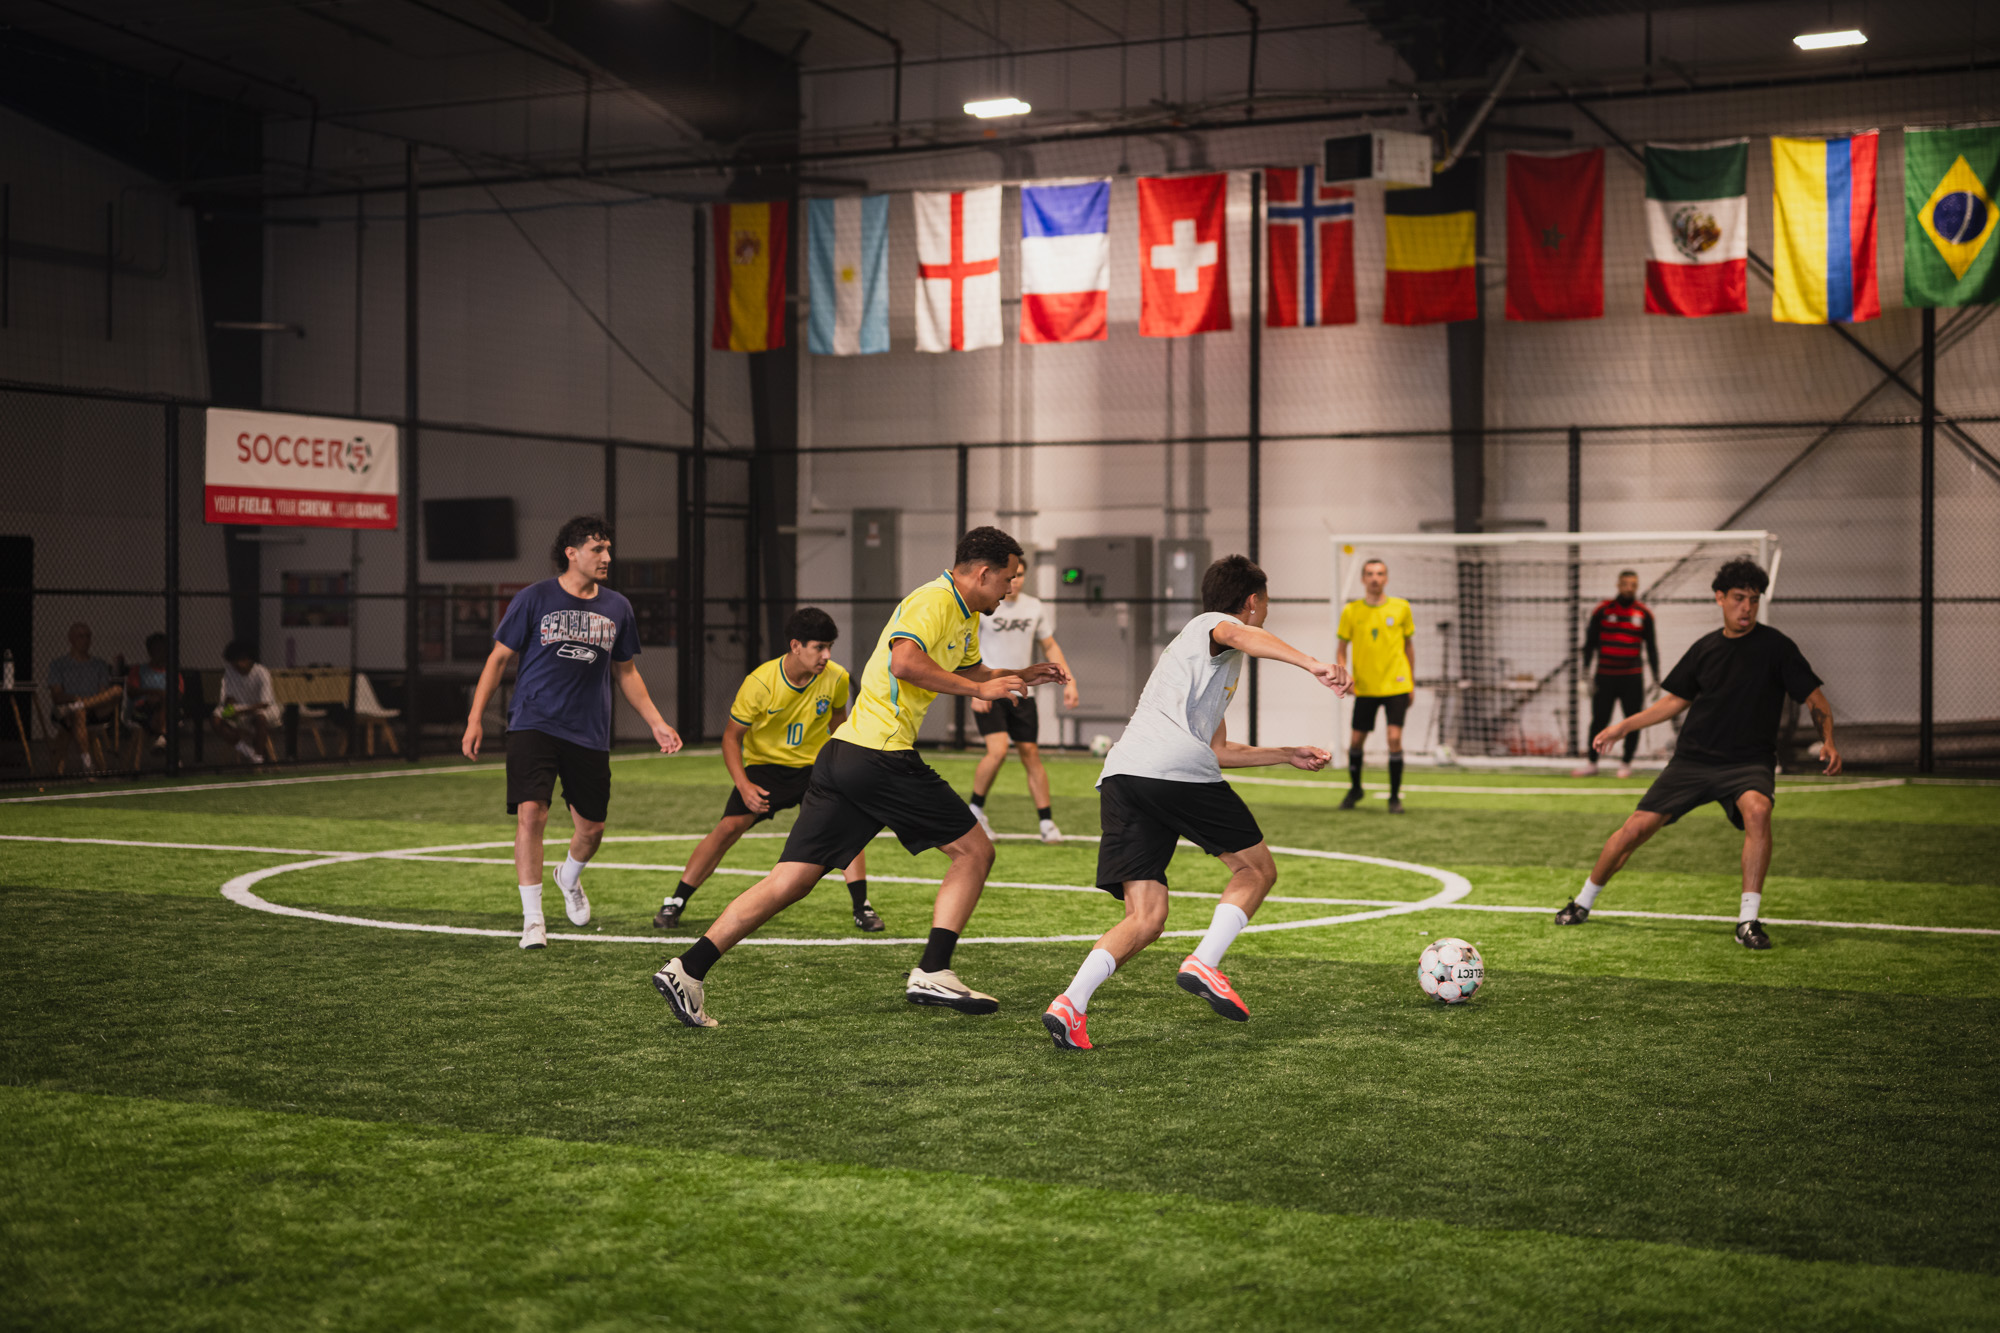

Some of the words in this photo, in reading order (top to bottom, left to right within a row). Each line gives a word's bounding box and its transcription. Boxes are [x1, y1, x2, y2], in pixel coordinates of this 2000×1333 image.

[236, 431, 346, 469] SOCCER
[214, 495, 236, 513] YOUR
[238, 495, 272, 515] FIELD.
[540, 609, 616, 652] SEAHAWKS
[993, 617, 1032, 633] SURF
[787, 723, 803, 746] 10
